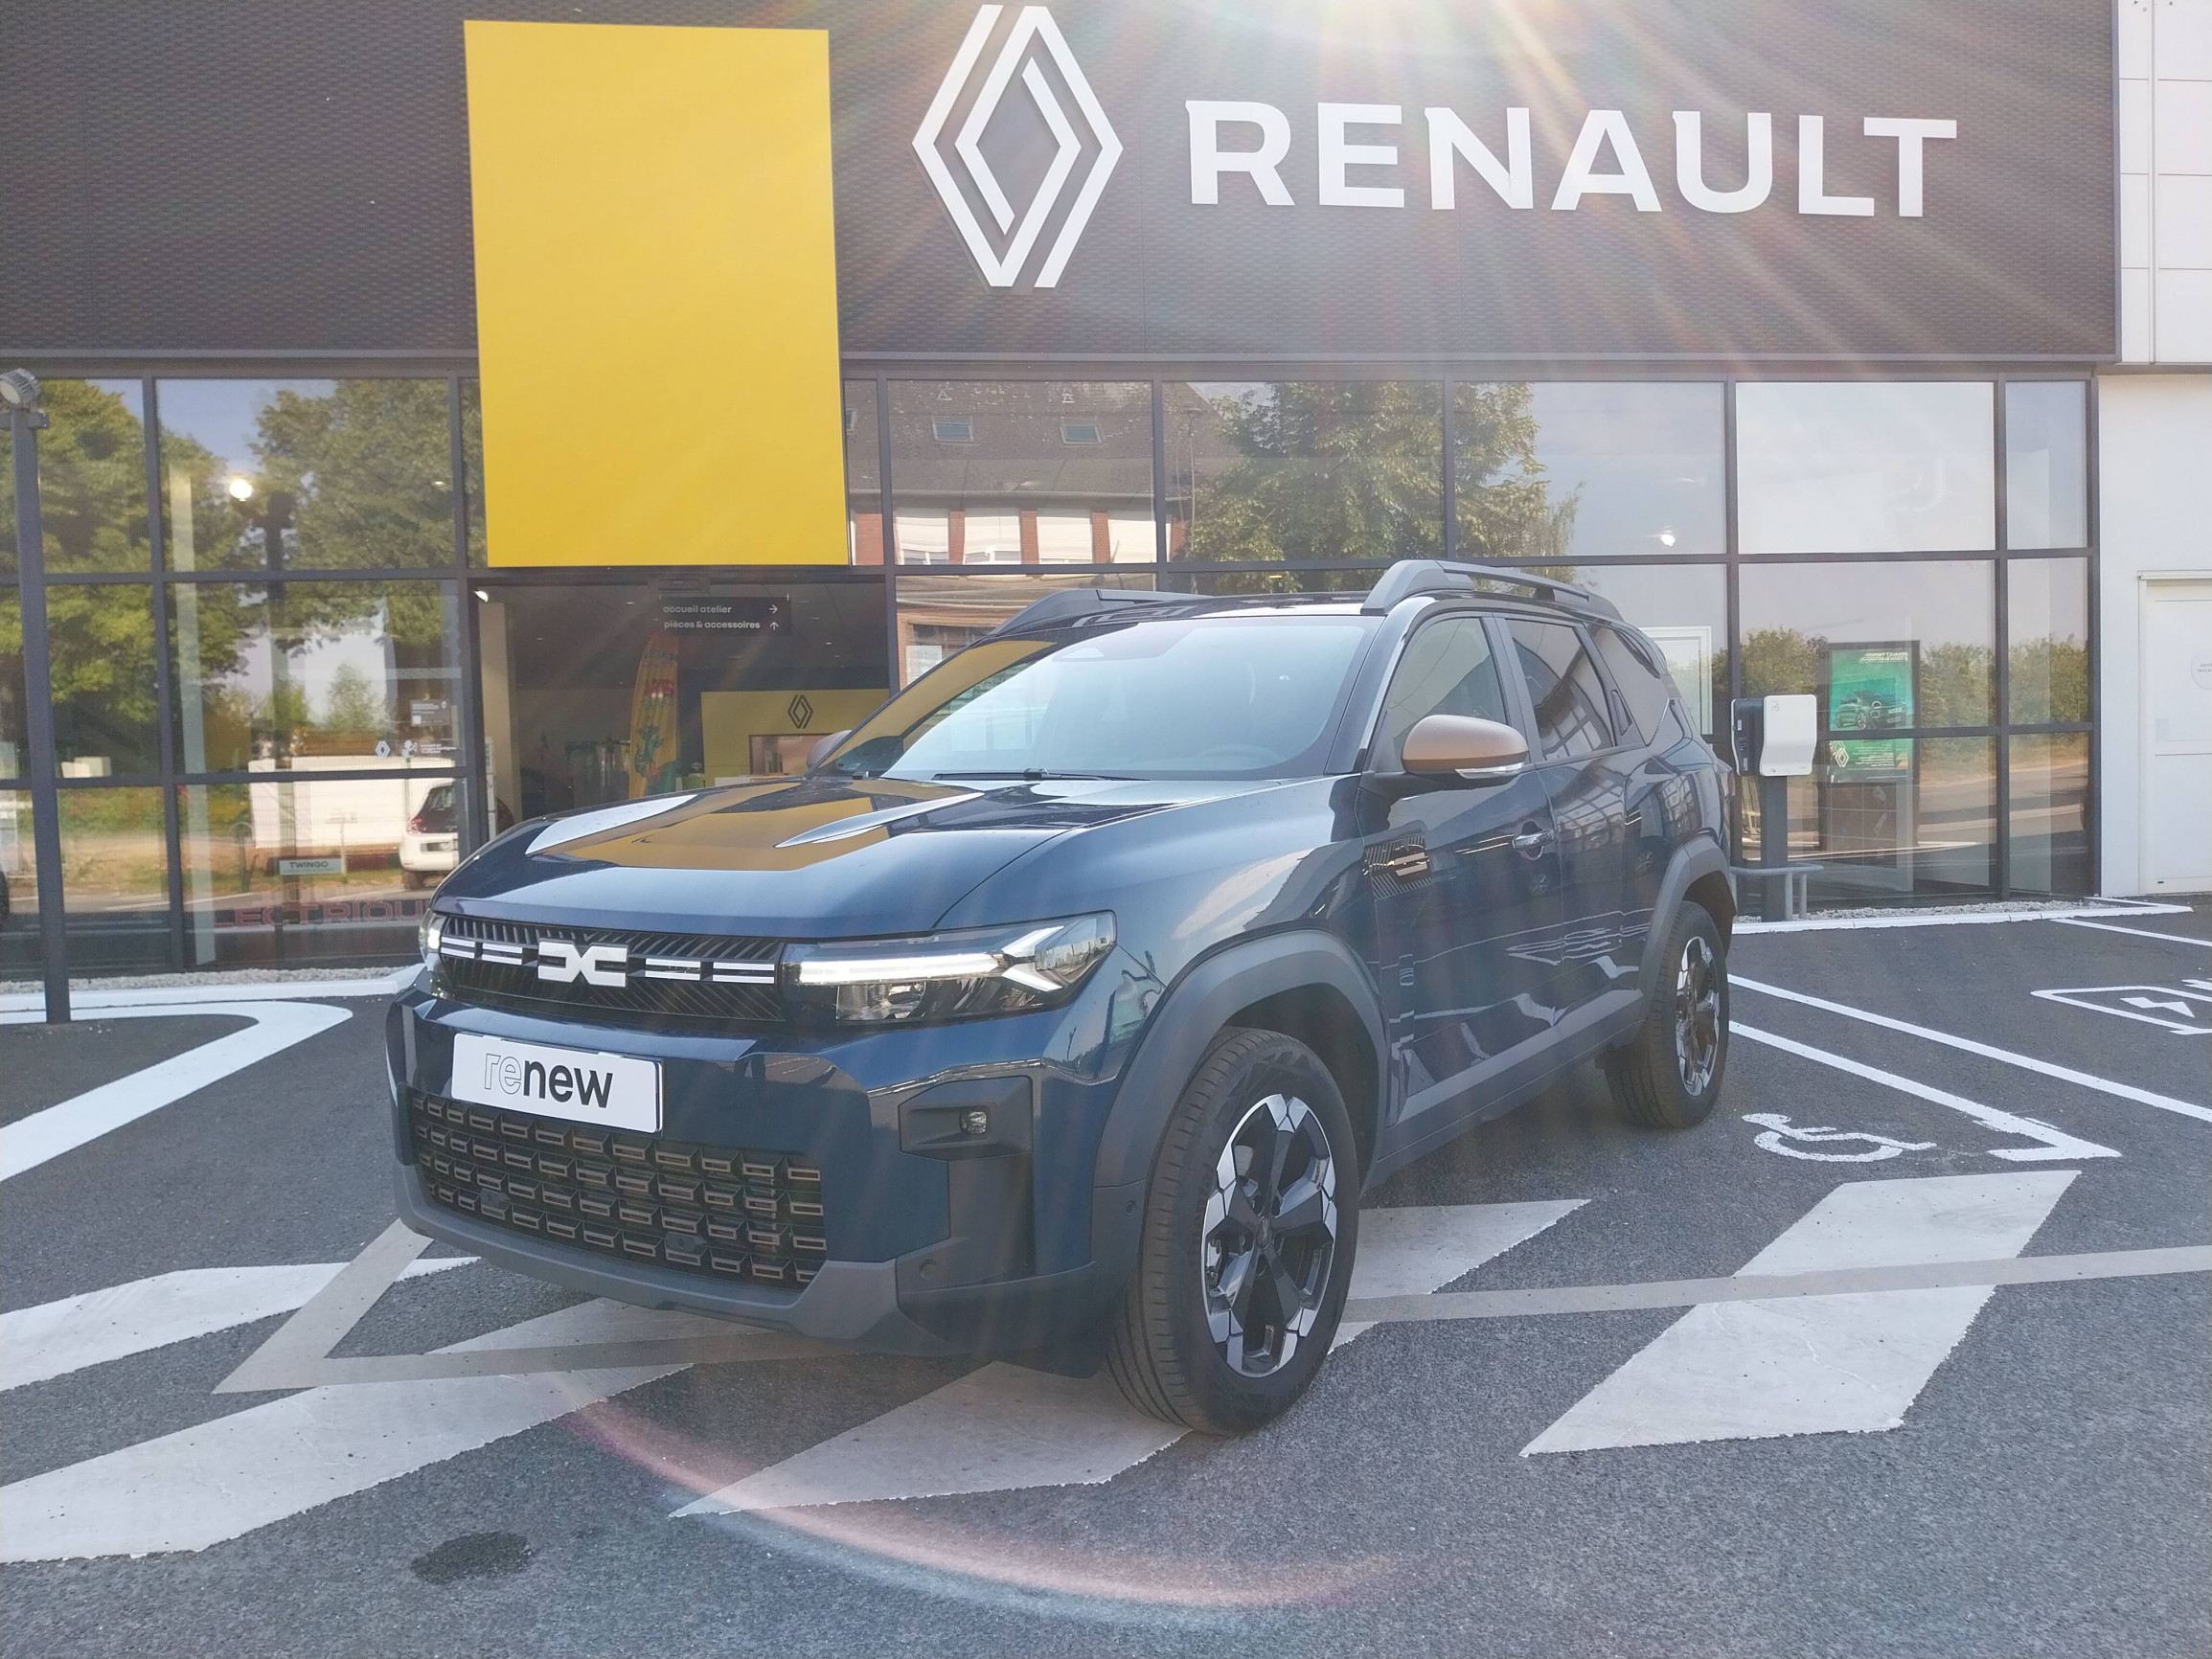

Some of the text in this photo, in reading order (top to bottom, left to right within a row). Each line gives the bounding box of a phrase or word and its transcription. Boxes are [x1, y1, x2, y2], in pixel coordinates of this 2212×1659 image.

[1185, 100, 1957, 217] RENAULT
[663, 604, 732, 614] accueil atelier
[664, 620, 696, 630] pièces
[704, 620, 761, 629] accessoires
[289, 860, 329, 869] TWINGO
[483, 1053, 613, 1109] renew
